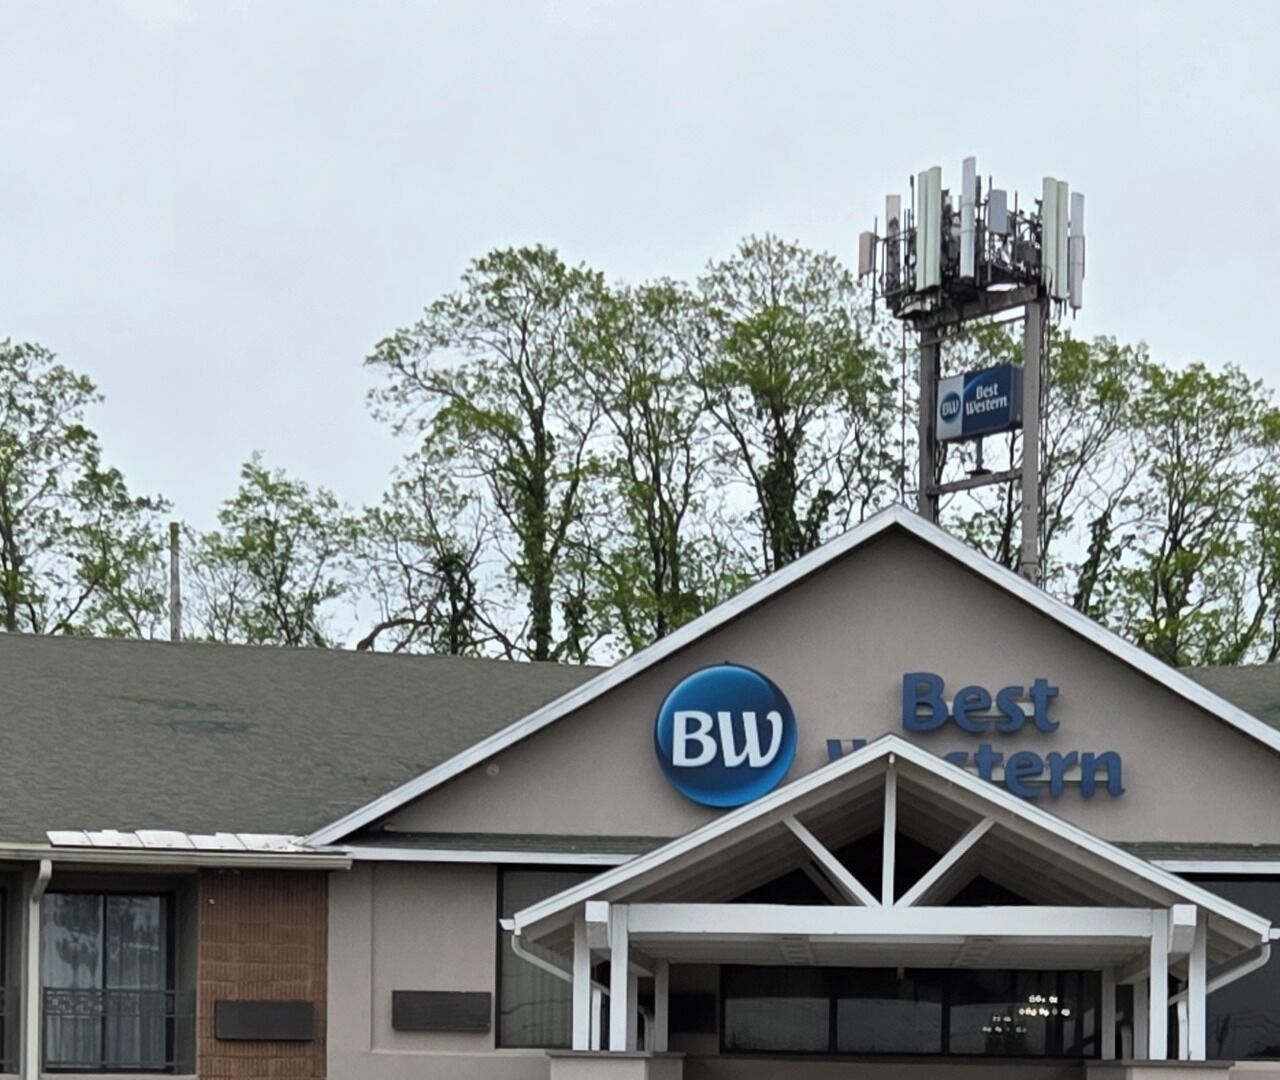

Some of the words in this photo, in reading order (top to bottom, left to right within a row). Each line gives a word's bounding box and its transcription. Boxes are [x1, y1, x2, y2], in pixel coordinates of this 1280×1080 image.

[942, 400, 959, 416] BW
[965, 395, 1007, 415] Western
[975, 383, 998, 399] Best
[902, 672, 1060, 733] Best
[672, 710, 783, 767] BW
[826, 739, 1125, 798] tern
